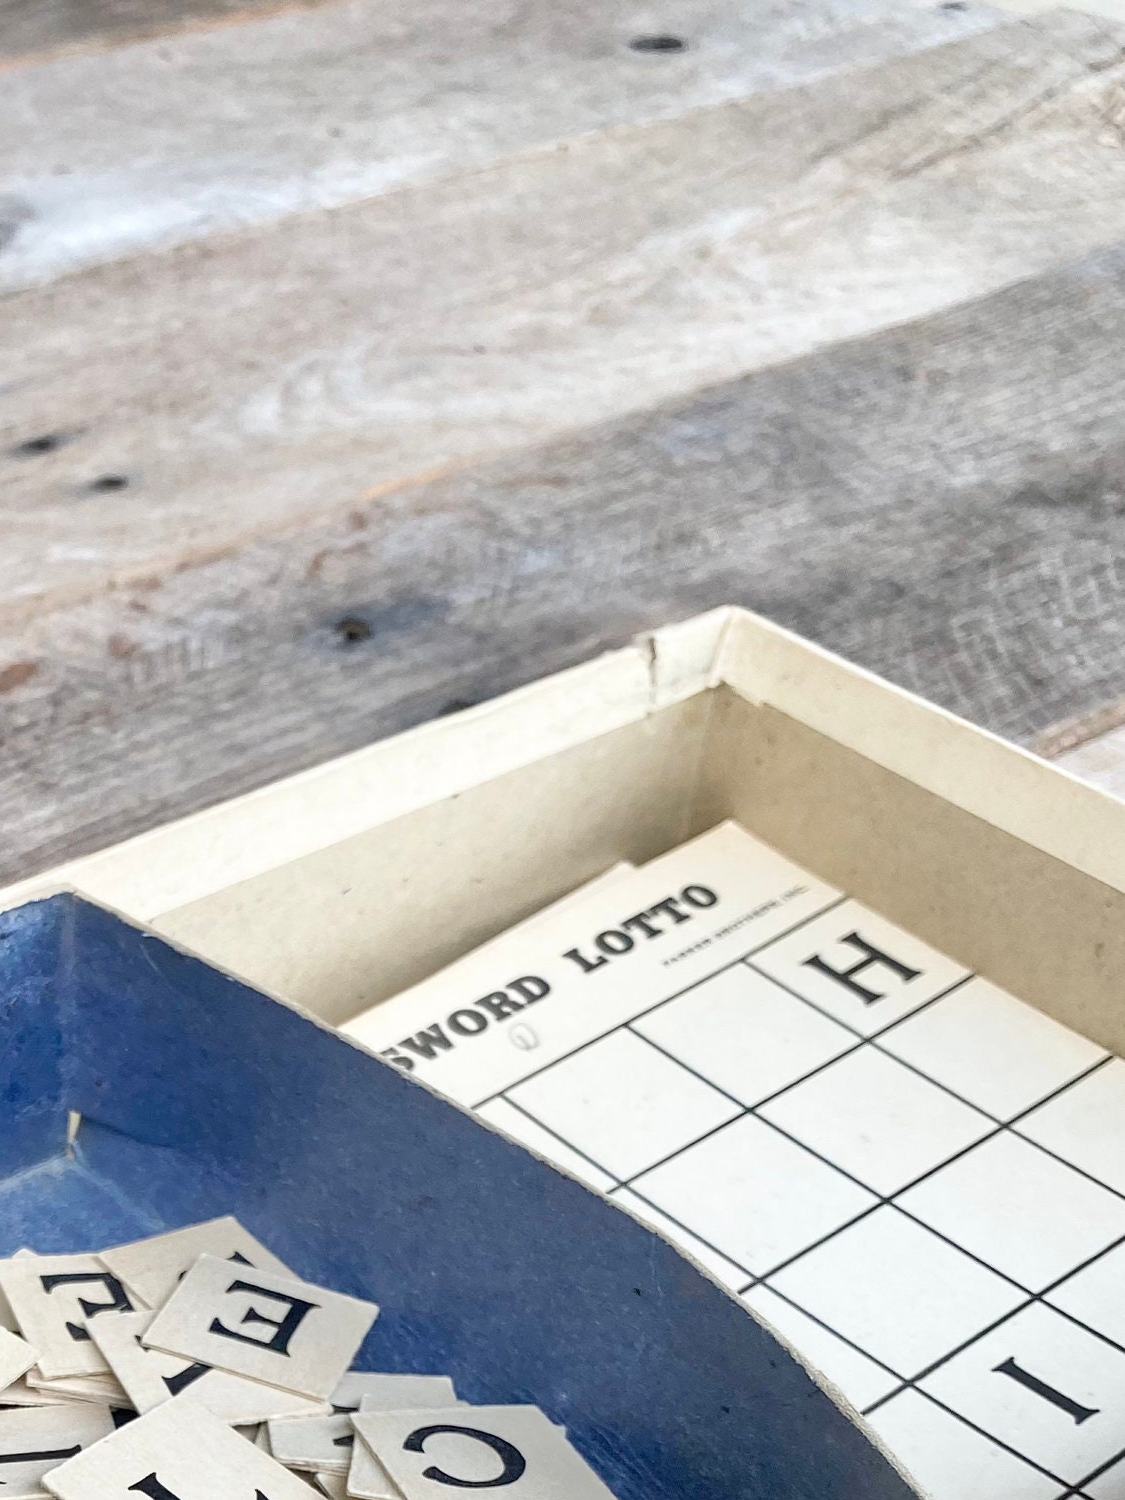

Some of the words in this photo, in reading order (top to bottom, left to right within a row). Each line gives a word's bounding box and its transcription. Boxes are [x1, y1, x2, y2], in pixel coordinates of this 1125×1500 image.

[563, 882, 719, 974] LOTTO
[801, 931, 925, 1008] H
[209, 1280, 321, 1358] E
[990, 1356, 1101, 1425] I
[402, 1424, 527, 1489] C
